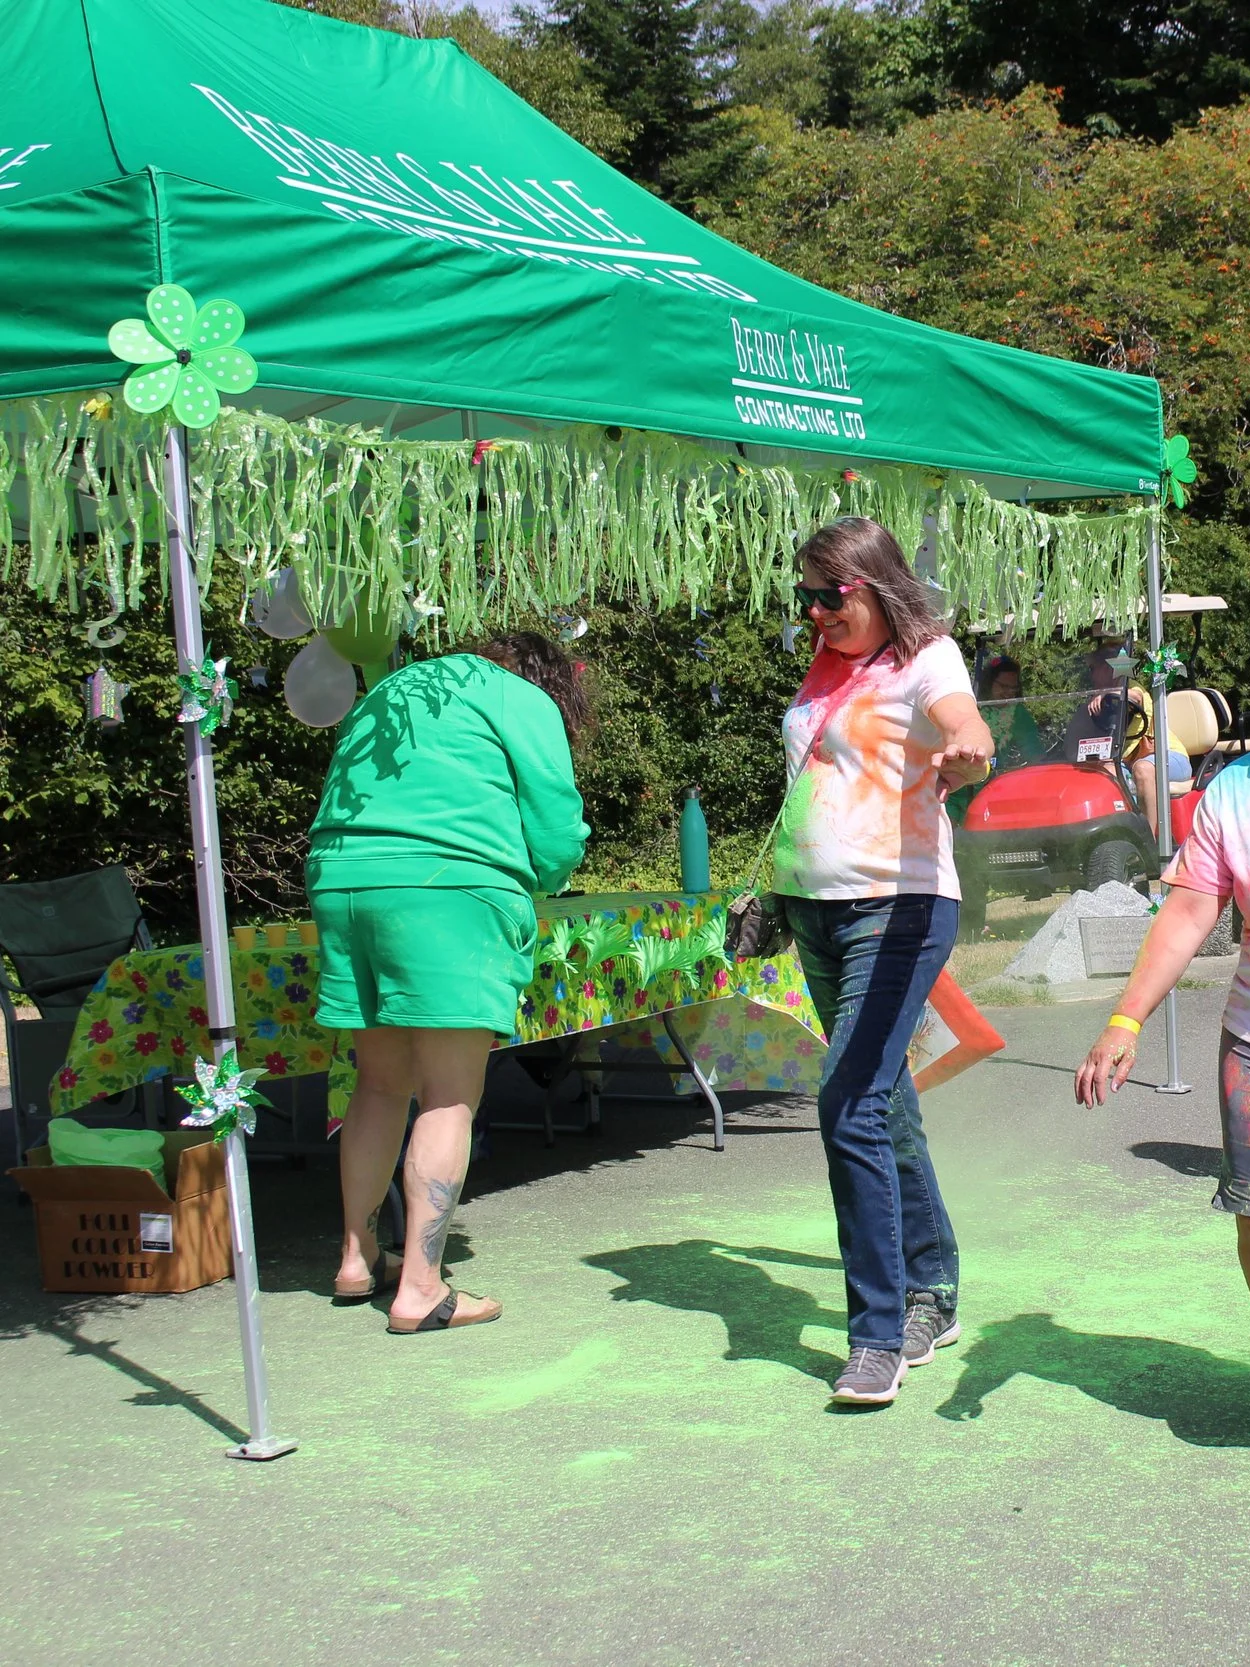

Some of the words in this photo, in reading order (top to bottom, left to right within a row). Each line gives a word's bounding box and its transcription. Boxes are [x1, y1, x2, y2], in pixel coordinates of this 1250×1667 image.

[190, 83, 453, 217] BERRY
[438, 161, 647, 245] VALE
[730, 317, 789, 380] BERRY
[790, 329, 811, 384] &
[804, 332, 851, 390] VALE
[734, 395, 840, 436] CONTRACTING
[840, 411, 866, 440] LTD
[63, 1260, 156, 1280] POWDER
